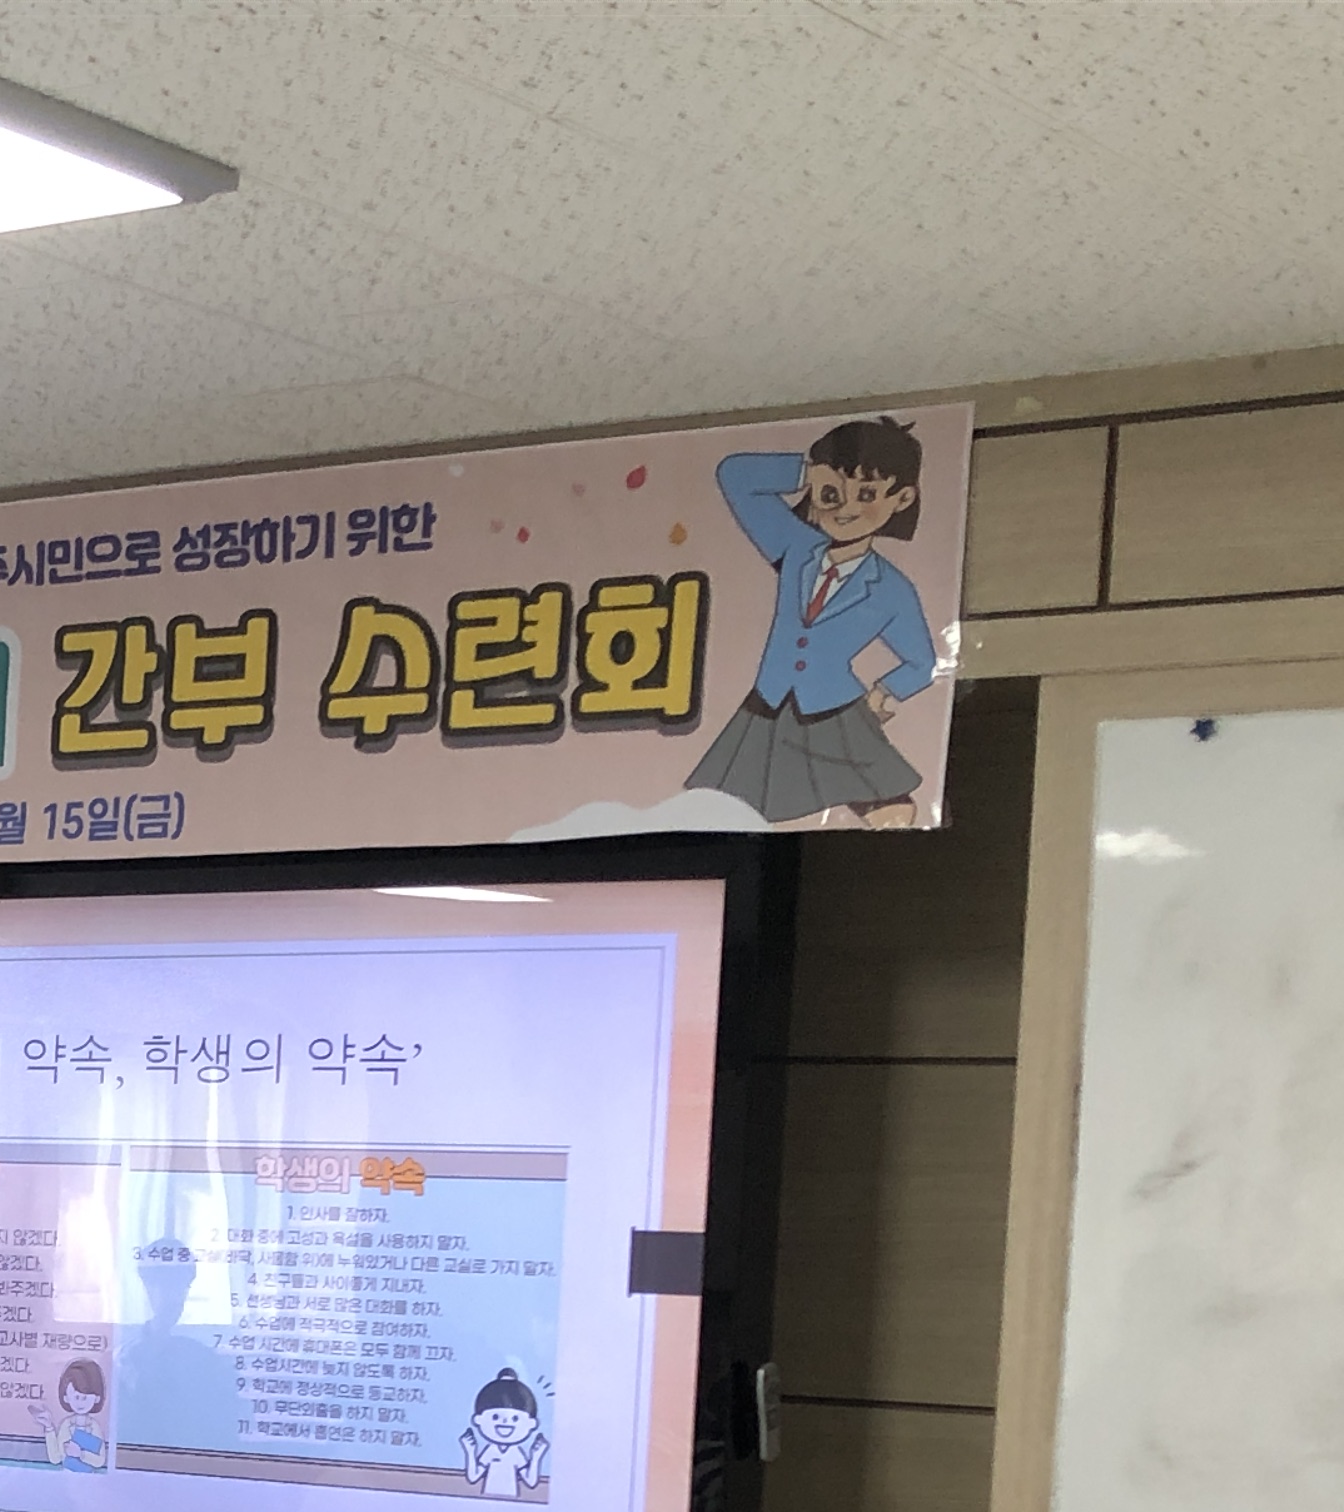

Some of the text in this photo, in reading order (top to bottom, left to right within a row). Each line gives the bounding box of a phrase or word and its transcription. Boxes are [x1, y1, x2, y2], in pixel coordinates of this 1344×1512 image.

[172, 510, 336, 574] 성장하기
[346, 501, 438, 558] 위한
[54, 608, 278, 768] 간부
[318, 571, 710, 752] 수련회
[42, 791, 186, 843] 15일(금)
[22, 1033, 124, 1090] 약속,
[141, 1033, 283, 1085] 학생의
[255, 1155, 426, 1197] 학생의 약속
[300, 1205, 340, 1222] 인사를
[287, 1231, 328, 1246] 고성과
[377, 1233, 433, 1250] 사용하지
[147, 1246, 174, 1262] 수업
[177, 1247, 191, 1262] 중
[410, 1256, 440, 1272] 다른
[443, 1257, 487, 1274] 교실로
[490, 1259, 519, 1276] 가지
[303, 1297, 331, 1311] 서로
[334, 1297, 362, 1313] 많은
[255, 1316, 295, 1331] 수업에
[299, 1317, 367, 1335] 적극적으로
[228, 1335, 255, 1350] 수업
[258, 1337, 299, 1353] 시간에
[360, 1342, 389, 1358] 모두
[252, 1378, 293, 1395] 학교에
[297, 1380, 365, 1400] 정상적으로
[346, 1405, 374, 1421] 하지
[257, 1421, 311, 1439] 학교에서
[359, 1428, 387, 1445] 하지
